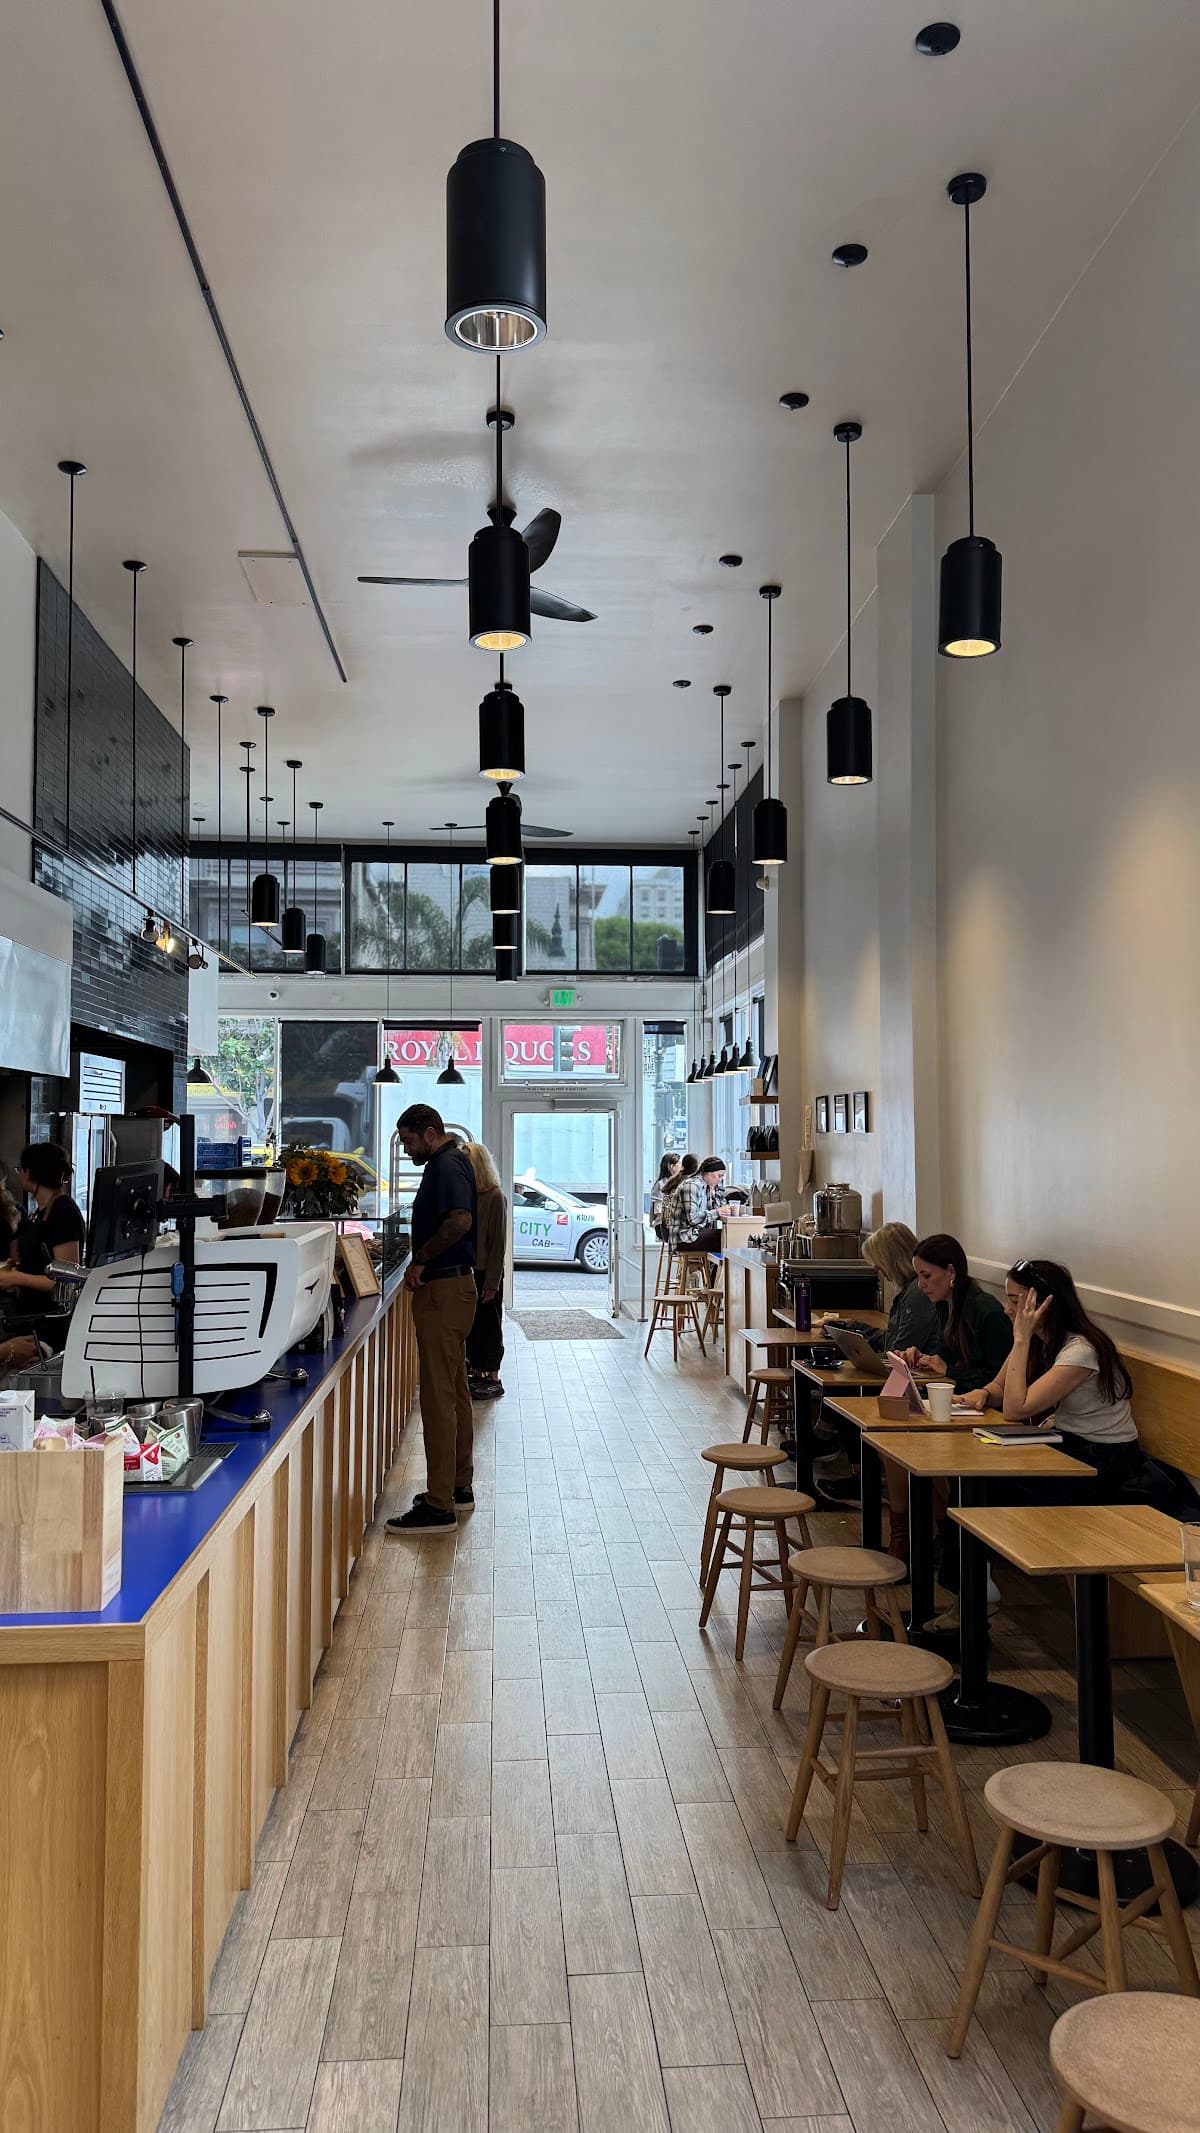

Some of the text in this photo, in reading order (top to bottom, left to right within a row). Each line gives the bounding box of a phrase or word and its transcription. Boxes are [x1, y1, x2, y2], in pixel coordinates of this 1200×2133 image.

[384, 1040, 591, 1065] ROYL QUOS
[519, 1221, 552, 1237] CITY
[531, 1238, 551, 1248] CAB
